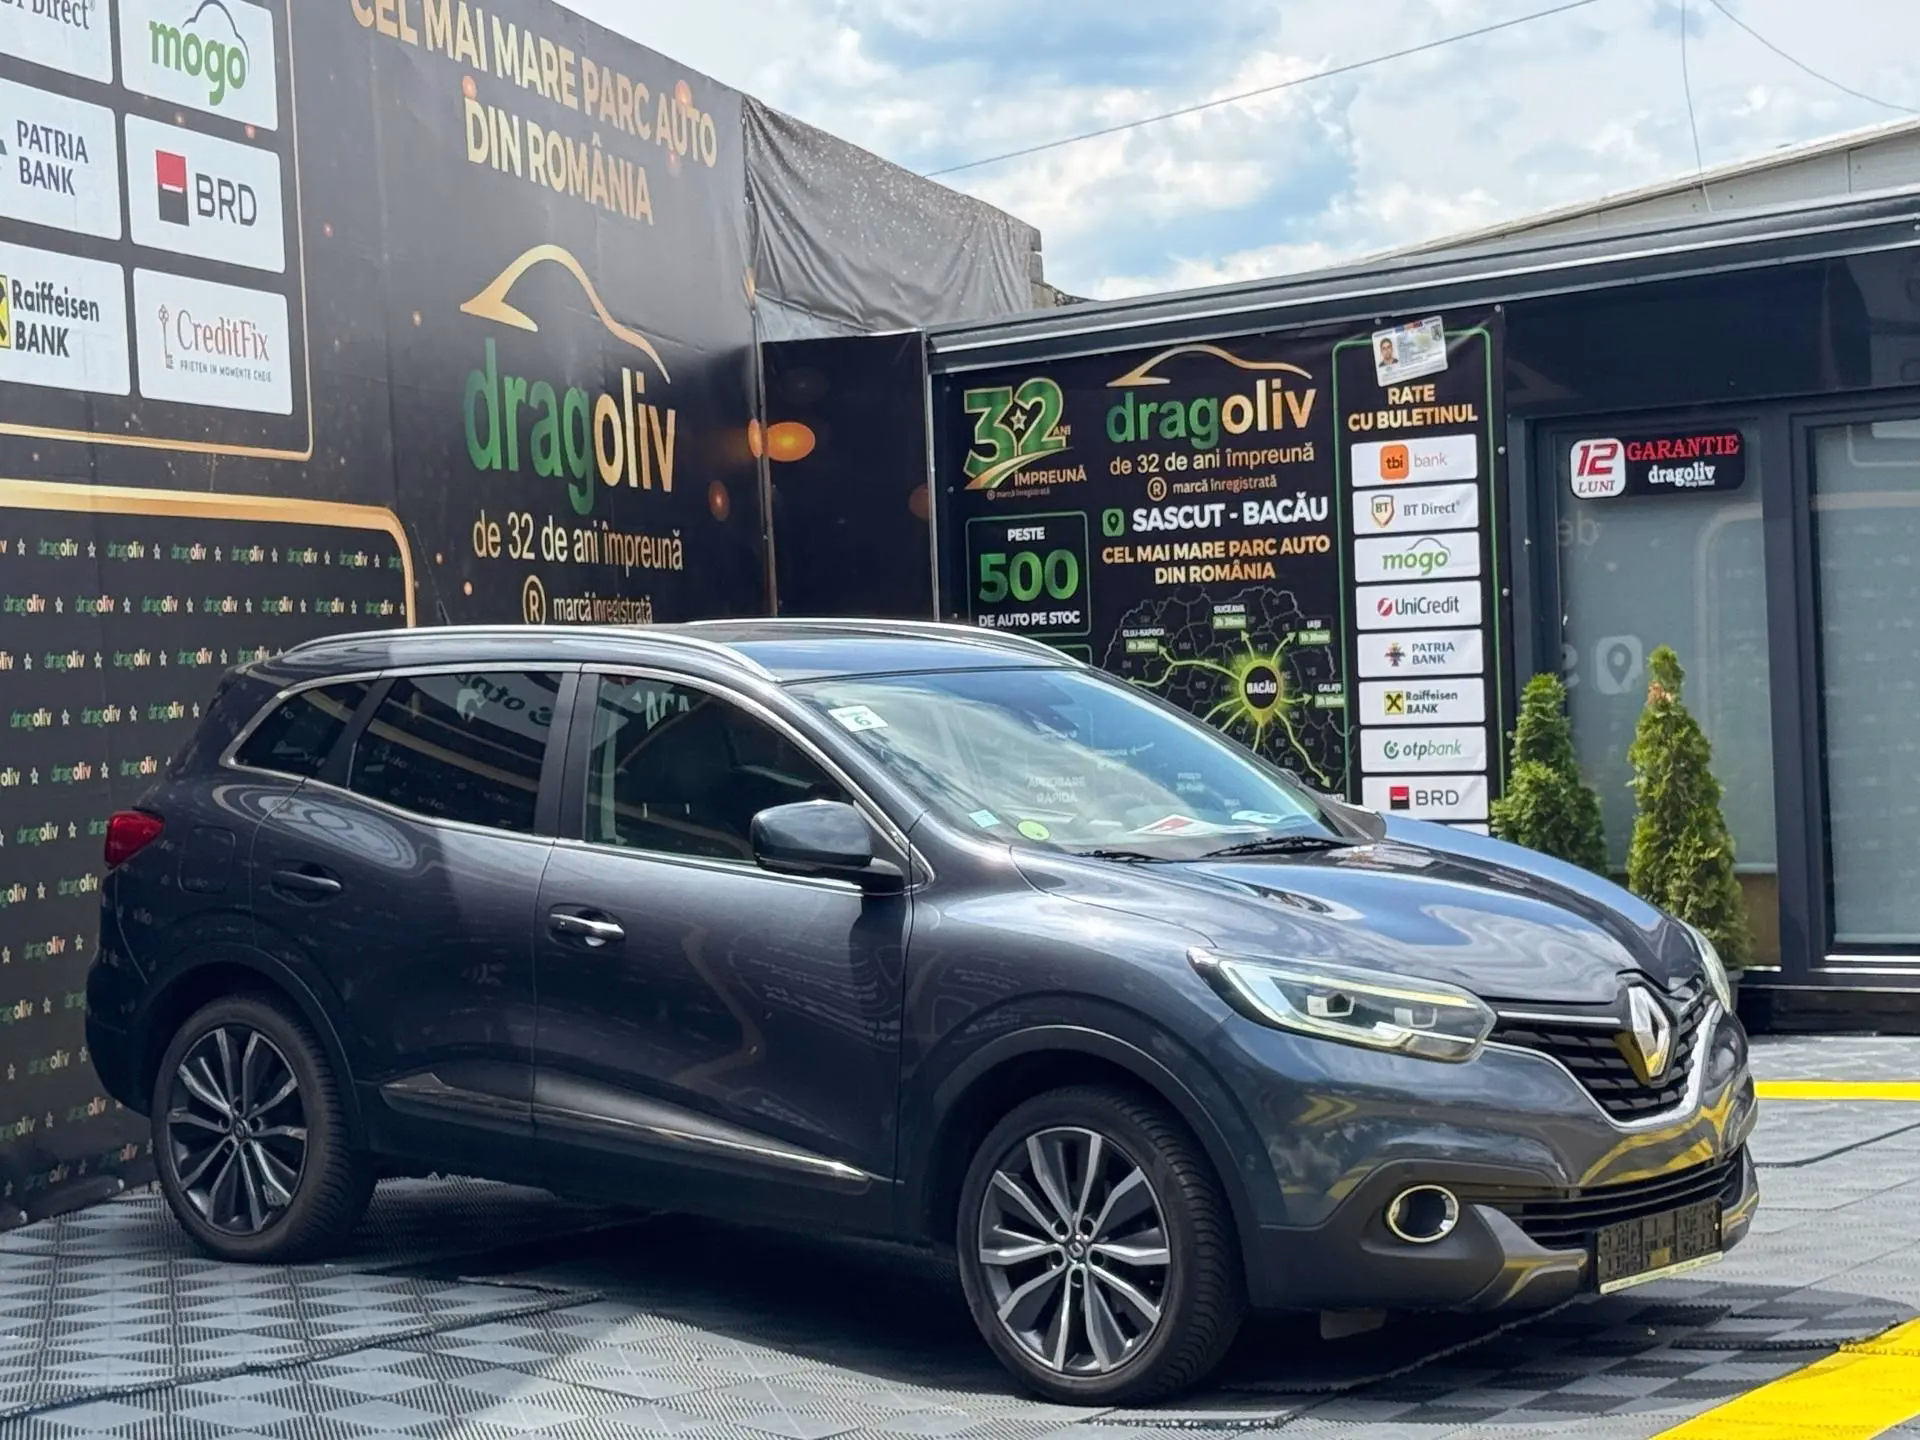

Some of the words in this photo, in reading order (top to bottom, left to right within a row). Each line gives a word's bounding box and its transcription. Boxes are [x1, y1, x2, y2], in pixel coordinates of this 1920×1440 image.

[149, 20, 247, 106] mogo
[424, 0, 488, 72] MAI
[492, 15, 578, 111] MARE
[580, 56, 652, 139] PARC
[656, 92, 718, 168] AUTO
[17, 120, 89, 164] PATRIA
[464, 97, 522, 178] DIN
[527, 120, 654, 226] ROMÂNIA
[19, 161, 76, 196] BANK
[195, 173, 257, 227] BRD
[12, 279, 100, 322] Raiffeisen
[15, 320, 70, 358] BANK
[177, 309, 270, 362] CreditFix
[180, 359, 207, 373] PRIETEN
[220, 367, 251, 380] MOMENTE
[1388, 384, 1436, 405] RATE
[463, 337, 676, 515] dragoliv
[1105, 378, 1317, 449] dragoliv
[1348, 413, 1374, 431] CU
[1377, 404, 1478, 429] BULETINUL
[963, 377, 1064, 479] 32
[1052, 424, 1071, 437] ANI
[1110, 457, 1132, 475] de
[1137, 454, 1160, 473] 32
[1165, 452, 1187, 472] de
[1193, 449, 1220, 469] ani
[1226, 442, 1315, 471] împreună
[1386, 455, 1404, 470] tbi
[1414, 452, 1448, 468] bank
[1577, 443, 1618, 477] 12
[1627, 435, 1739, 461] GARANTIE
[1173, 478, 1209, 495] marcă
[1210, 475, 1278, 494] înregistrată
[1578, 480, 1616, 493] LUNI
[1648, 462, 1716, 487] dragoliv
[1132, 503, 1226, 532] SASCUT
[1243, 492, 1329, 527] BACĂU
[1375, 503, 1389, 513] BT
[1403, 504, 1420, 516] BT
[473, 509, 501, 558] de
[508, 512, 535, 560] 32
[541, 515, 568, 562] de
[573, 520, 599, 564] ani
[603, 520, 684, 577] împreună
[1007, 526, 1045, 542] PESTE
[1102, 547, 1136, 564] CEL
[1139, 543, 1171, 562] MAI
[1174, 540, 1227, 560] MARE
[1229, 537, 1277, 557] PARC
[1280, 535, 1331, 555] AUTO
[979, 550, 1079, 602] 500
[1155, 567, 1189, 584] DIN
[1191, 560, 1276, 582] ROMÂNIA
[1382, 551, 1448, 575] mogo
[553, 592, 593, 622] marcă
[979, 615, 995, 627] DE
[997, 613, 1029, 626] AUTO
[1030, 612, 1047, 625] PE
[1049, 610, 1080, 625] STOC
[1395, 596, 1460, 615] UniCredit
[1412, 641, 1455, 653] PATRIA
[1412, 654, 1446, 665] BANK
[1247, 680, 1277, 694] BACĂU
[1406, 690, 1458, 701] Raiffeisen
[10, 707, 52, 731] dragoliv
[80, 704, 121, 728] dragoliv
[147, 701, 184, 723] dragoliv
[1407, 703, 1439, 714] BANK
[1403, 740, 1462, 760] otpbank
[51, 761, 91, 784] dragoliv
[119, 756, 157, 779] dragoliv
[1415, 790, 1460, 806] BRD
[17, 822, 59, 846] dragoliv
